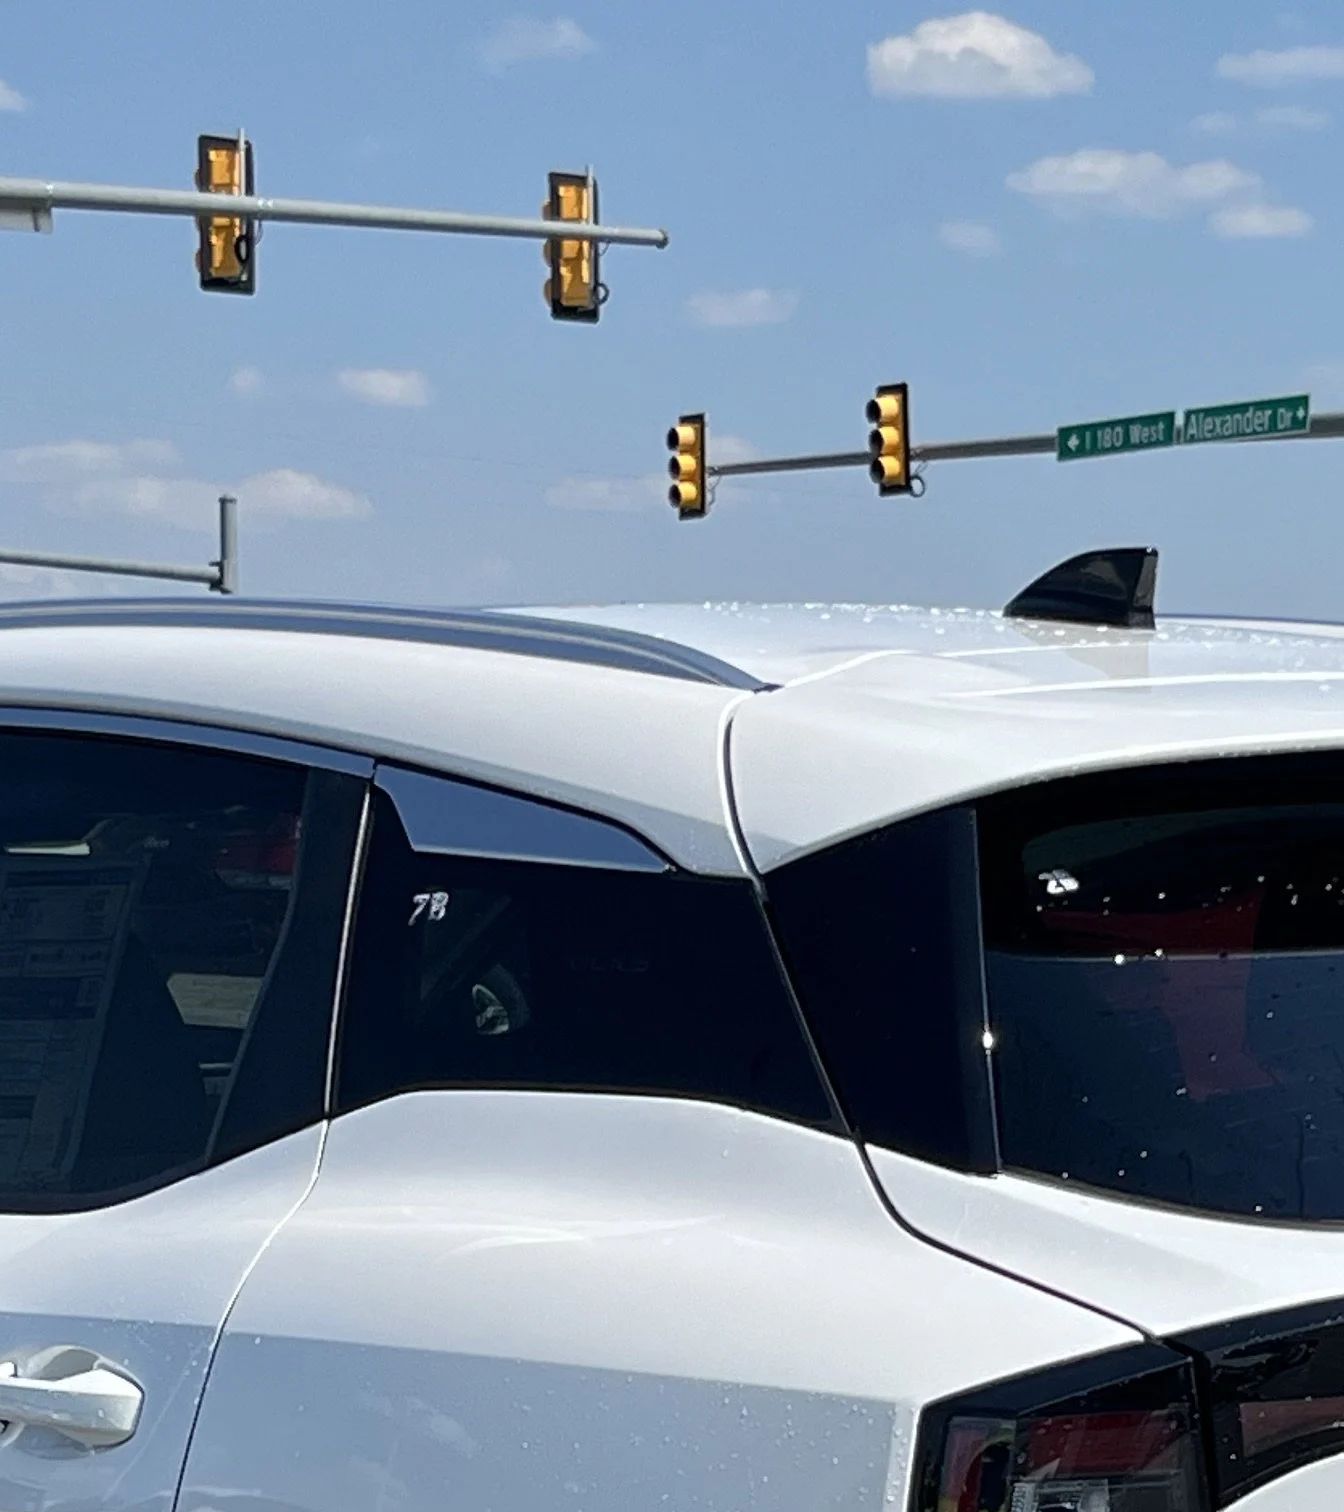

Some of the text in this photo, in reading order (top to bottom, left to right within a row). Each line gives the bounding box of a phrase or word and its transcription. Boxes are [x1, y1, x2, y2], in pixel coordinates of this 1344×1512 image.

[1085, 420, 1165, 450] I 180 West
[1186, 406, 1293, 440] Alexander Dr
